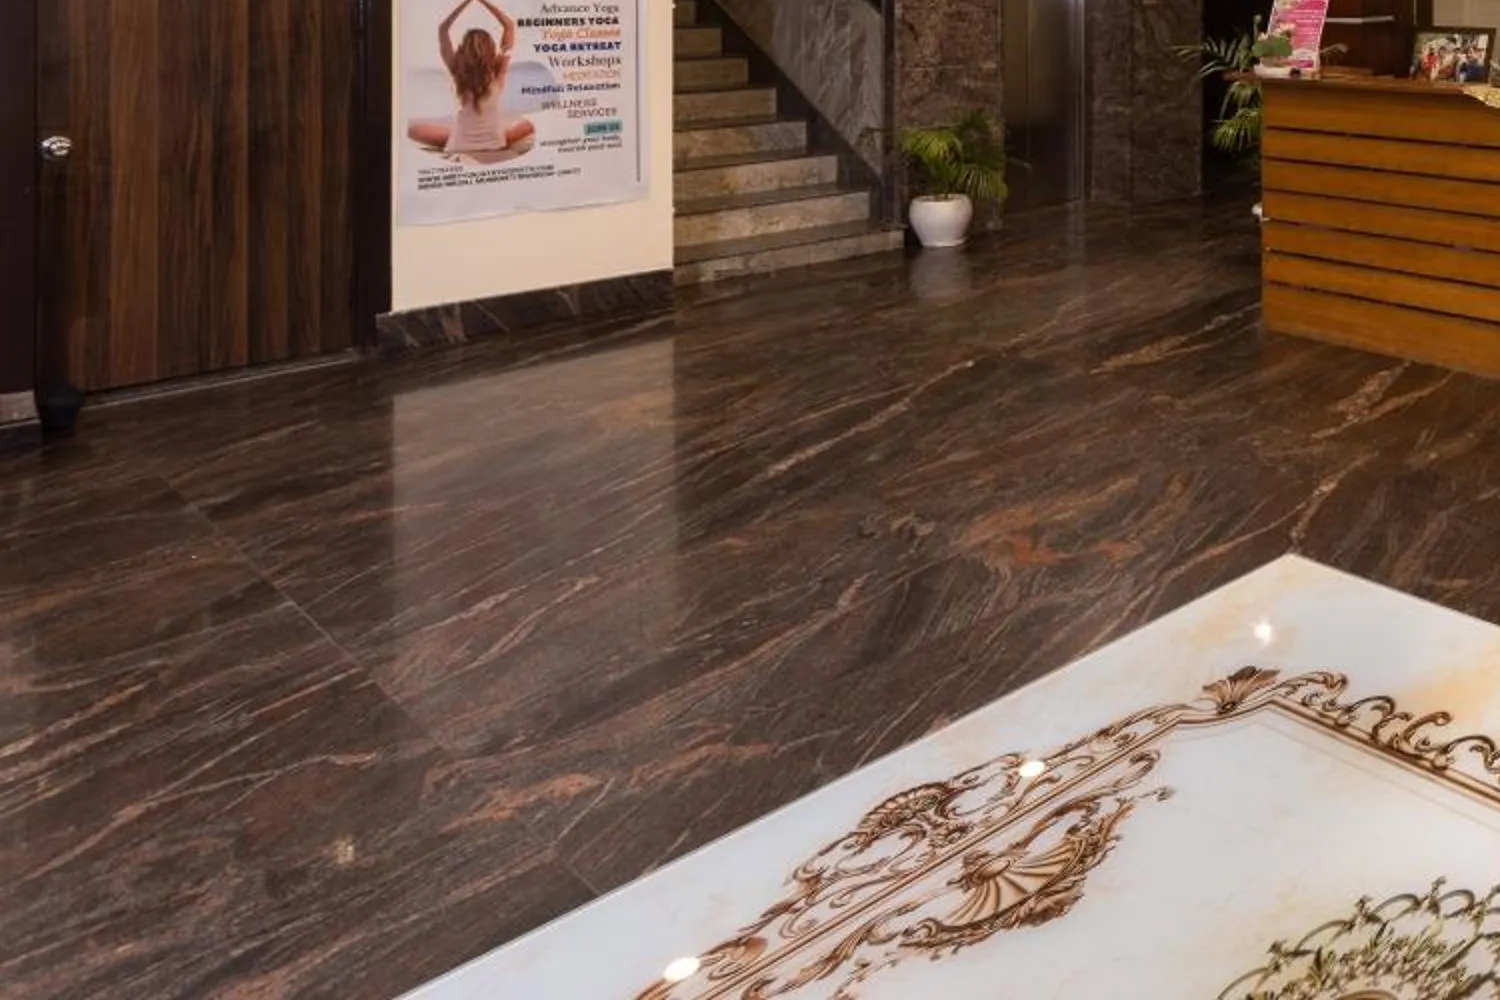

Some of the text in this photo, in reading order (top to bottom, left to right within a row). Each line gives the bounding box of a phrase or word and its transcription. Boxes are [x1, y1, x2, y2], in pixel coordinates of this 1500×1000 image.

[517, 16, 620, 28] BEGINNERS YOGA
[533, 42, 567, 53] YOGA
[548, 53, 622, 69] Workshops
